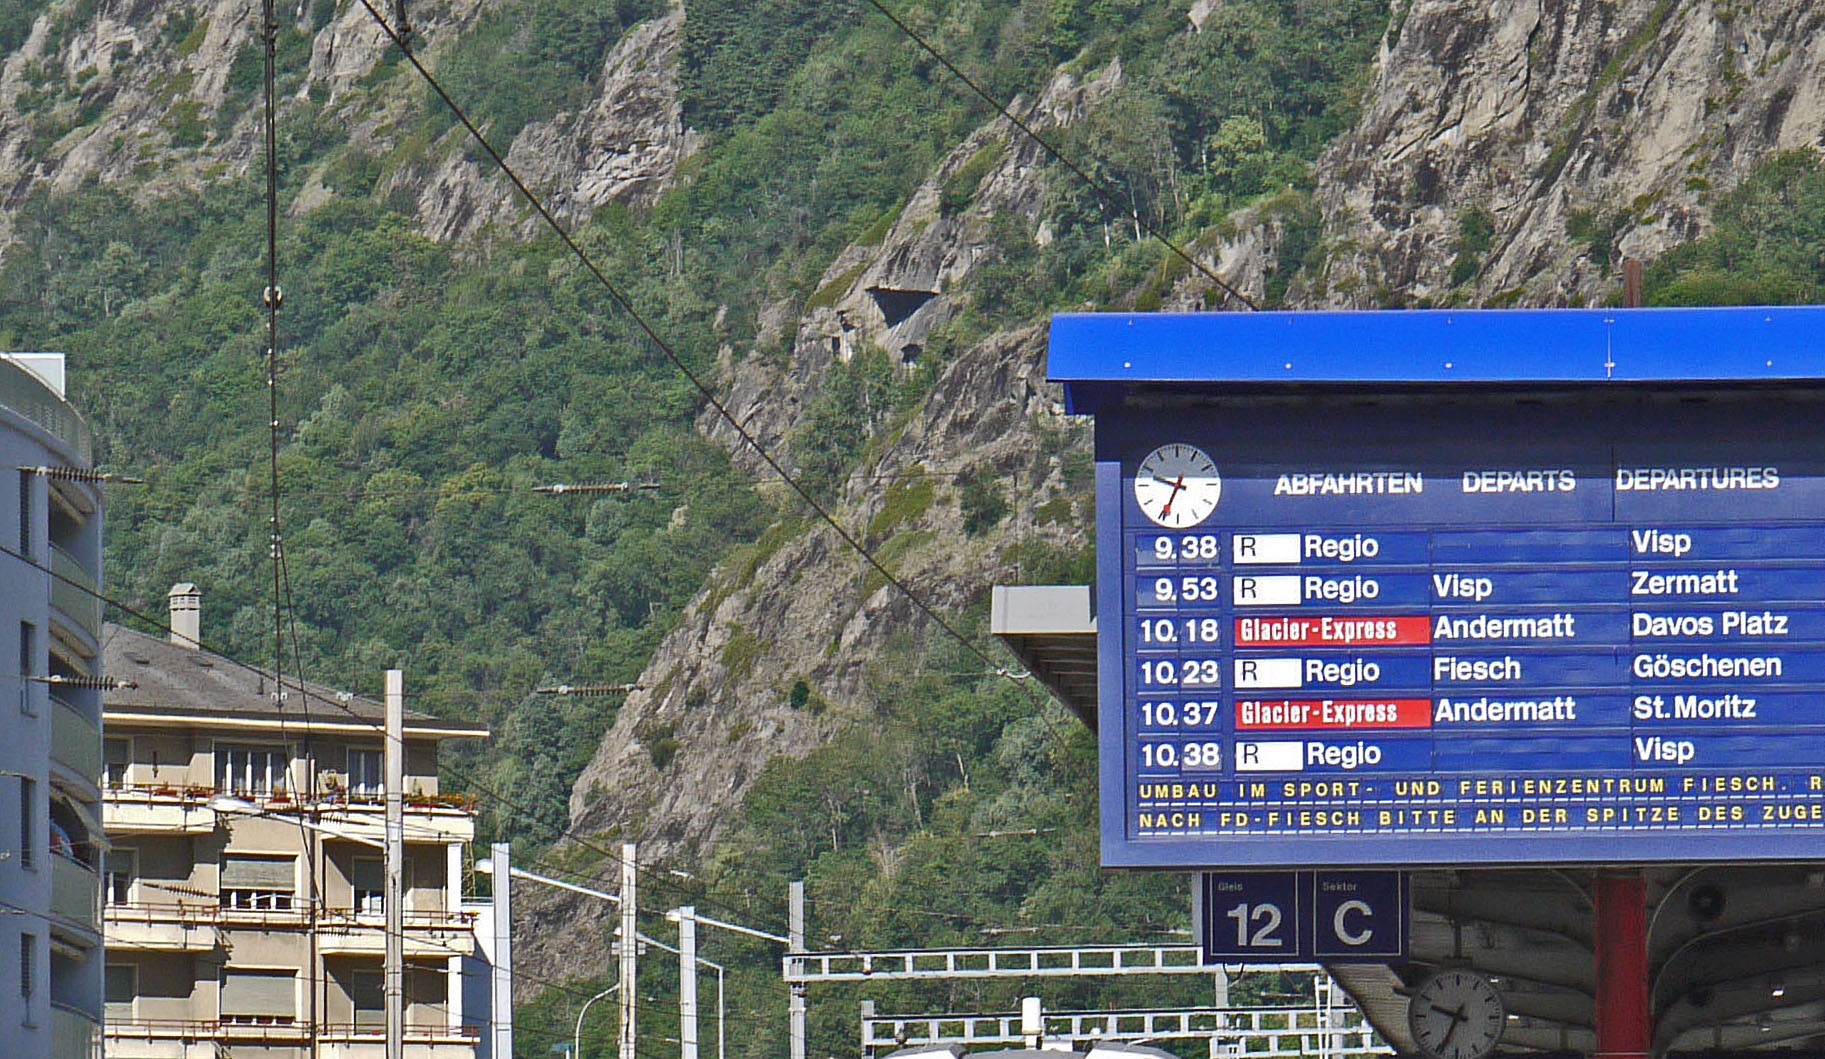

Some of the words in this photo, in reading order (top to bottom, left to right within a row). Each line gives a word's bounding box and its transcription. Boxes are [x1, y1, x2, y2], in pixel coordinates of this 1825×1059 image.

[1273, 472, 1423, 496] ABFAHRTEN
[1462, 470, 1576, 493] DEPARTS
[1615, 467, 1780, 491] DEPARTURES
[1154, 535, 1218, 559] 9.38
[1241, 536, 1256, 557] R
[1304, 533, 1379, 562] Regio
[1632, 529, 1692, 556] Visp
[1155, 576, 1218, 602] 9.53
[1241, 577, 1257, 599] R
[1305, 575, 1379, 603] Regio
[1432, 573, 1493, 602] Visp
[1631, 569, 1739, 595] Zermatt
[1140, 618, 1219, 643] 10.18
[1241, 617, 1397, 644] Glacier-Express
[1433, 614, 1575, 639] Andermatt
[1632, 612, 1714, 637] Davos
[1722, 611, 1789, 635] Platz
[1141, 660, 1219, 685] 10.23
[1242, 660, 1257, 681] R
[1306, 658, 1380, 686] Regio
[1434, 656, 1521, 681] Fiesch
[1633, 653, 1782, 678] Göschenen
[1142, 701, 1218, 726] 10.37
[1241, 700, 1398, 727] Glacier-Express
[1434, 696, 1576, 722] Andermatt
[1142, 743, 1220, 767] 10.38
[1243, 743, 1259, 765] R
[1307, 741, 1382, 769] Regio
[1633, 736, 1695, 765] Visp
[1139, 783, 1216, 799] UMBAU
[1239, 783, 1265, 798] IM
[1284, 782, 1373, 797] SPORT-
[1395, 781, 1440, 796] UND
[1460, 778, 1664, 796] FERIENZENTRUM
[1683, 776, 1786, 792] FIESCH.
[1139, 813, 1200, 828] NACH
[1220, 811, 1359, 827] FD-FIESCH
[1379, 810, 1455, 826] BITTE
[1475, 809, 1504, 824] AN
[1522, 808, 1567, 824] DER
[1587, 807, 1679, 823] SPITZE
[1698, 806, 1743, 821] DES
[1763, 805, 1822, 820] ZUGE
[1218, 882, 1244, 892] Gleis
[1322, 881, 1359, 892] Sektor
[1225, 902, 1284, 949] 12
[1331, 899, 1376, 948] C
